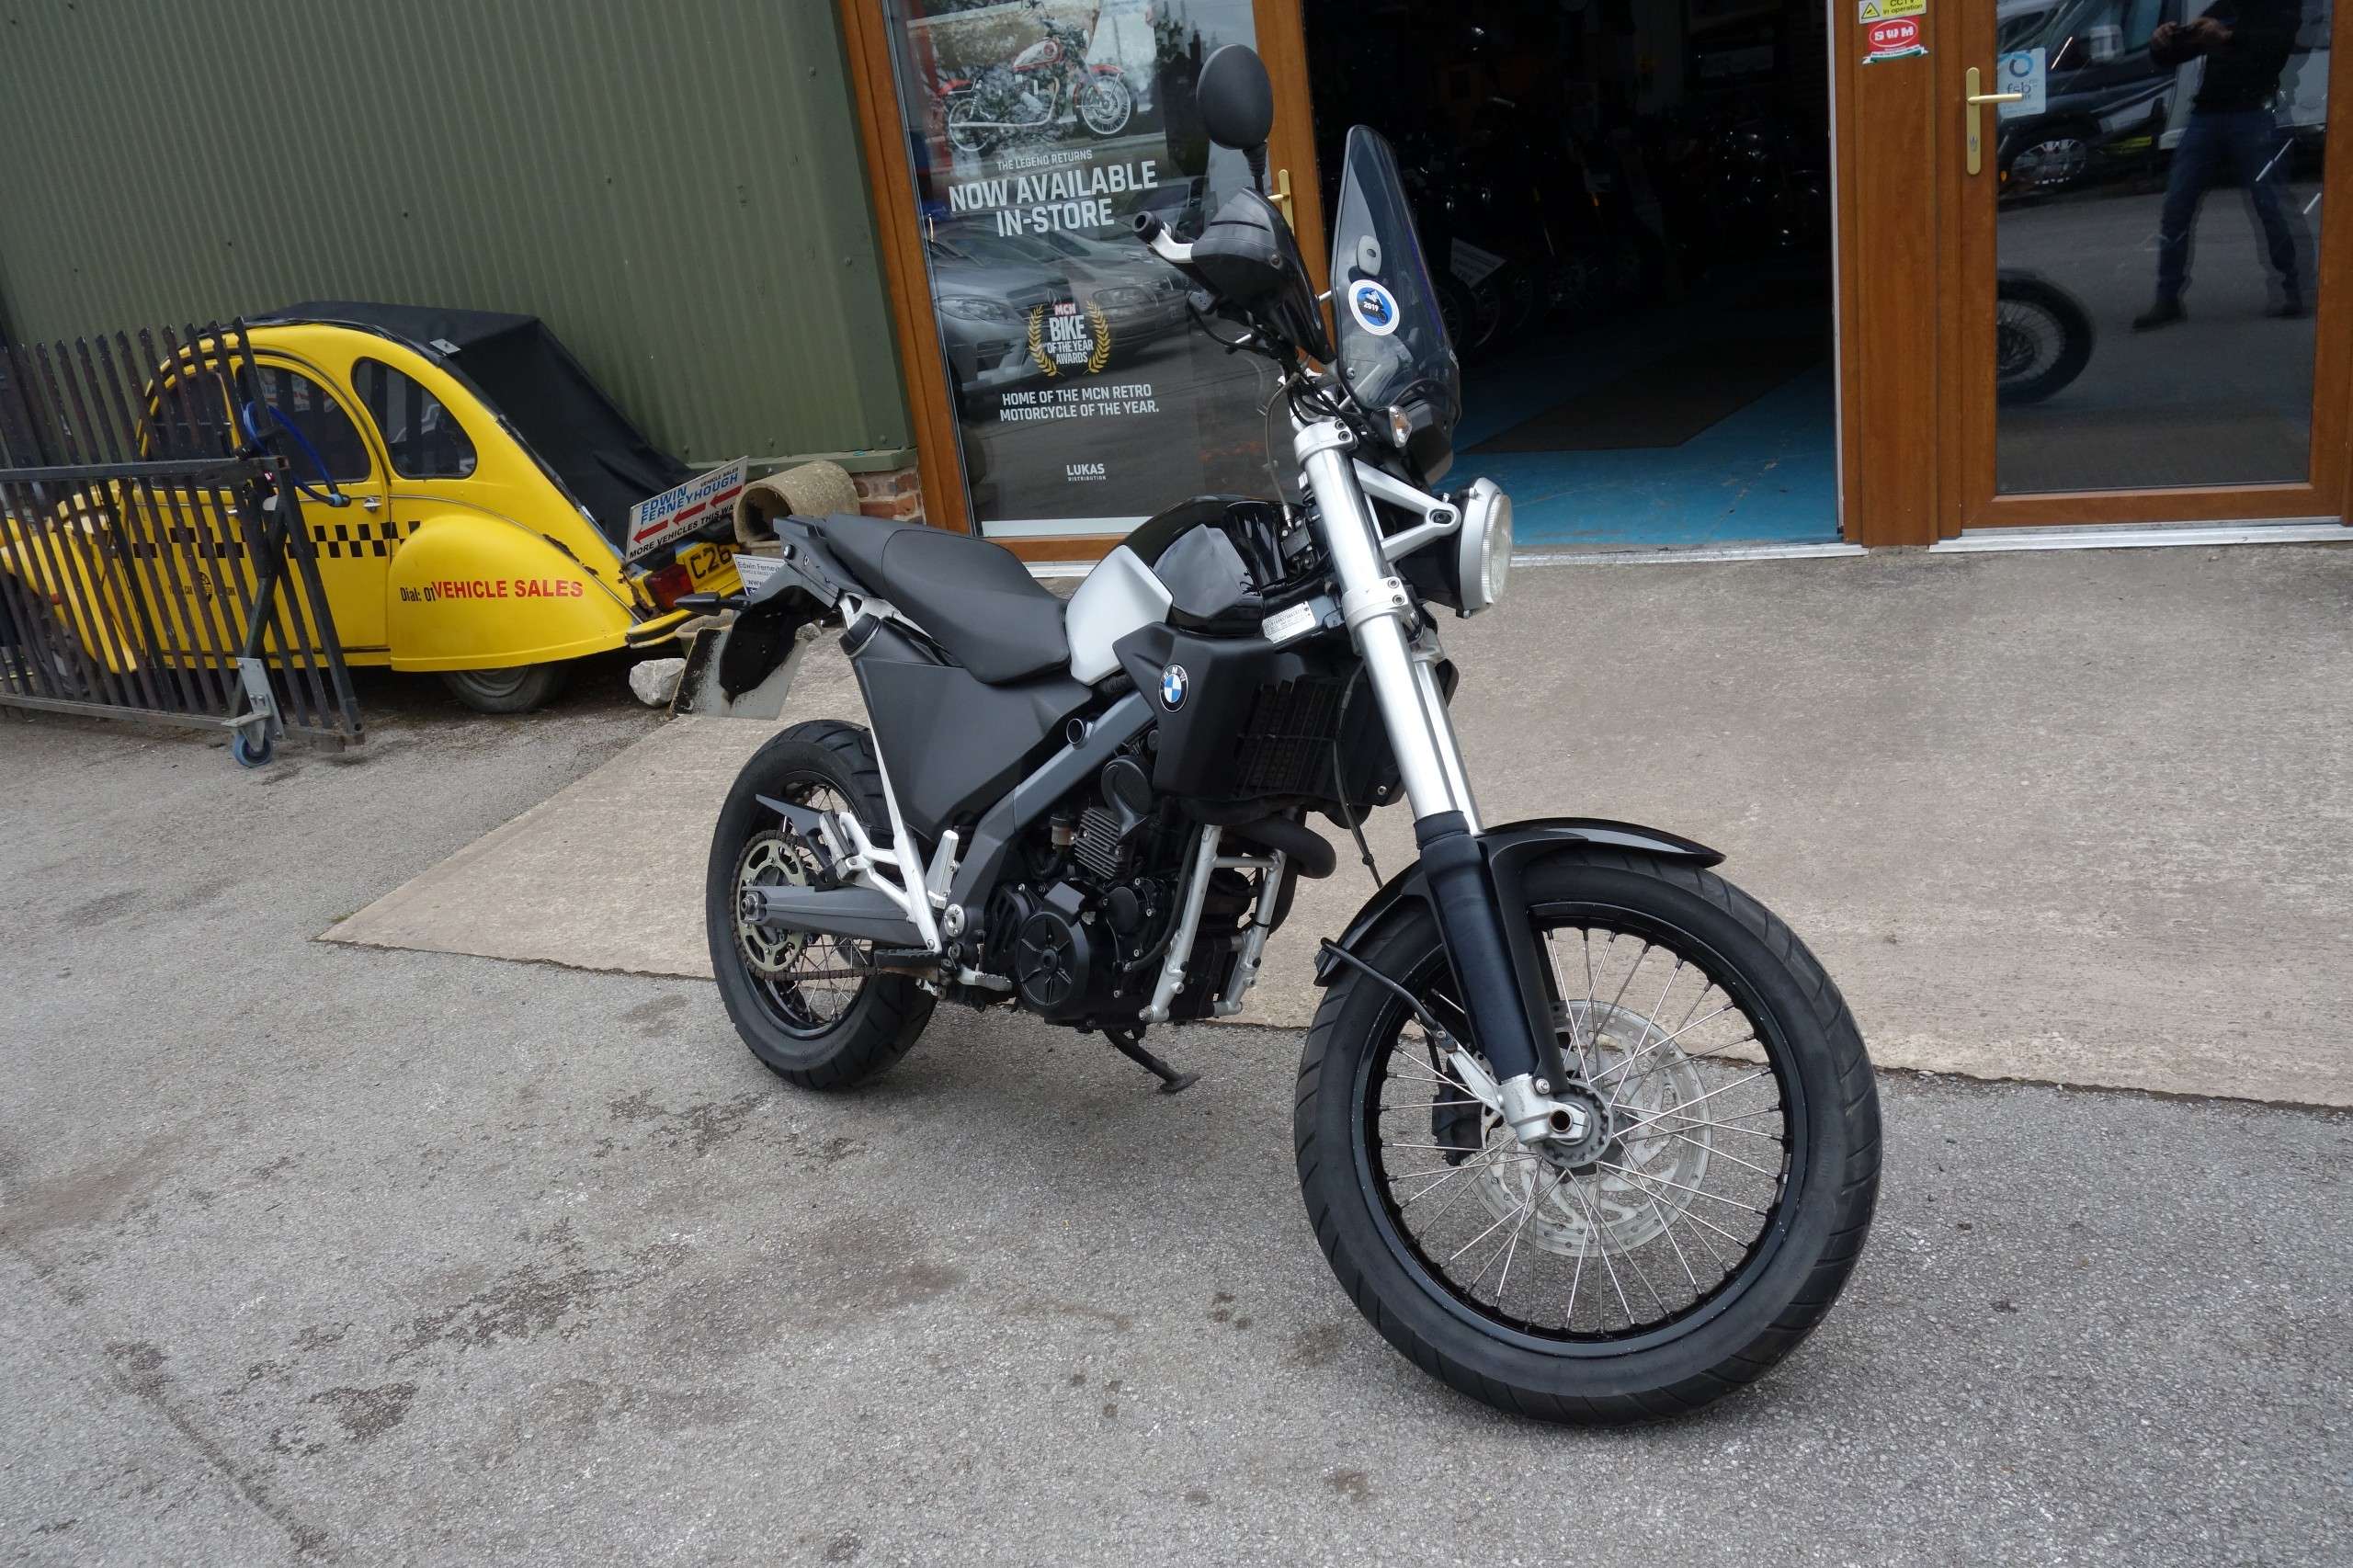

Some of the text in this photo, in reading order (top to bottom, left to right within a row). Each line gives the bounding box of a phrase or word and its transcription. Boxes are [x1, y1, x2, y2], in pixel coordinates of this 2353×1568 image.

[1891, 5, 1923, 15] operation
[1874, 26, 1914, 41] SWM
[996, 150, 1093, 171] THE LEGEND RETURNS
[949, 160, 1158, 212] NOW AVAILABLE
[995, 199, 1115, 237] IN-STORE
[1054, 303, 1076, 315] MCN
[1049, 315, 1086, 341] BIKE
[1047, 339, 1094, 353] OF THE YEAR
[1056, 351, 1088, 365] AWARDS
[1002, 384, 1152, 406] HOME OF THE MCN RETRO
[1000, 400, 1160, 422] MOTORCYCLE OF THE YEAR.
[699, 467, 739, 487] VEHICLE SALES
[1066, 463, 1105, 476] LUKAS
[641, 472, 738, 525] FERNEYHOUGH
[642, 485, 688, 516] EDWIN
[629, 503, 736, 559] MORE VEHICLES THIS WA
[400, 586, 422, 602] Dial:
[431, 580, 507, 598] VEHICLE
[515, 580, 584, 597] SALES
